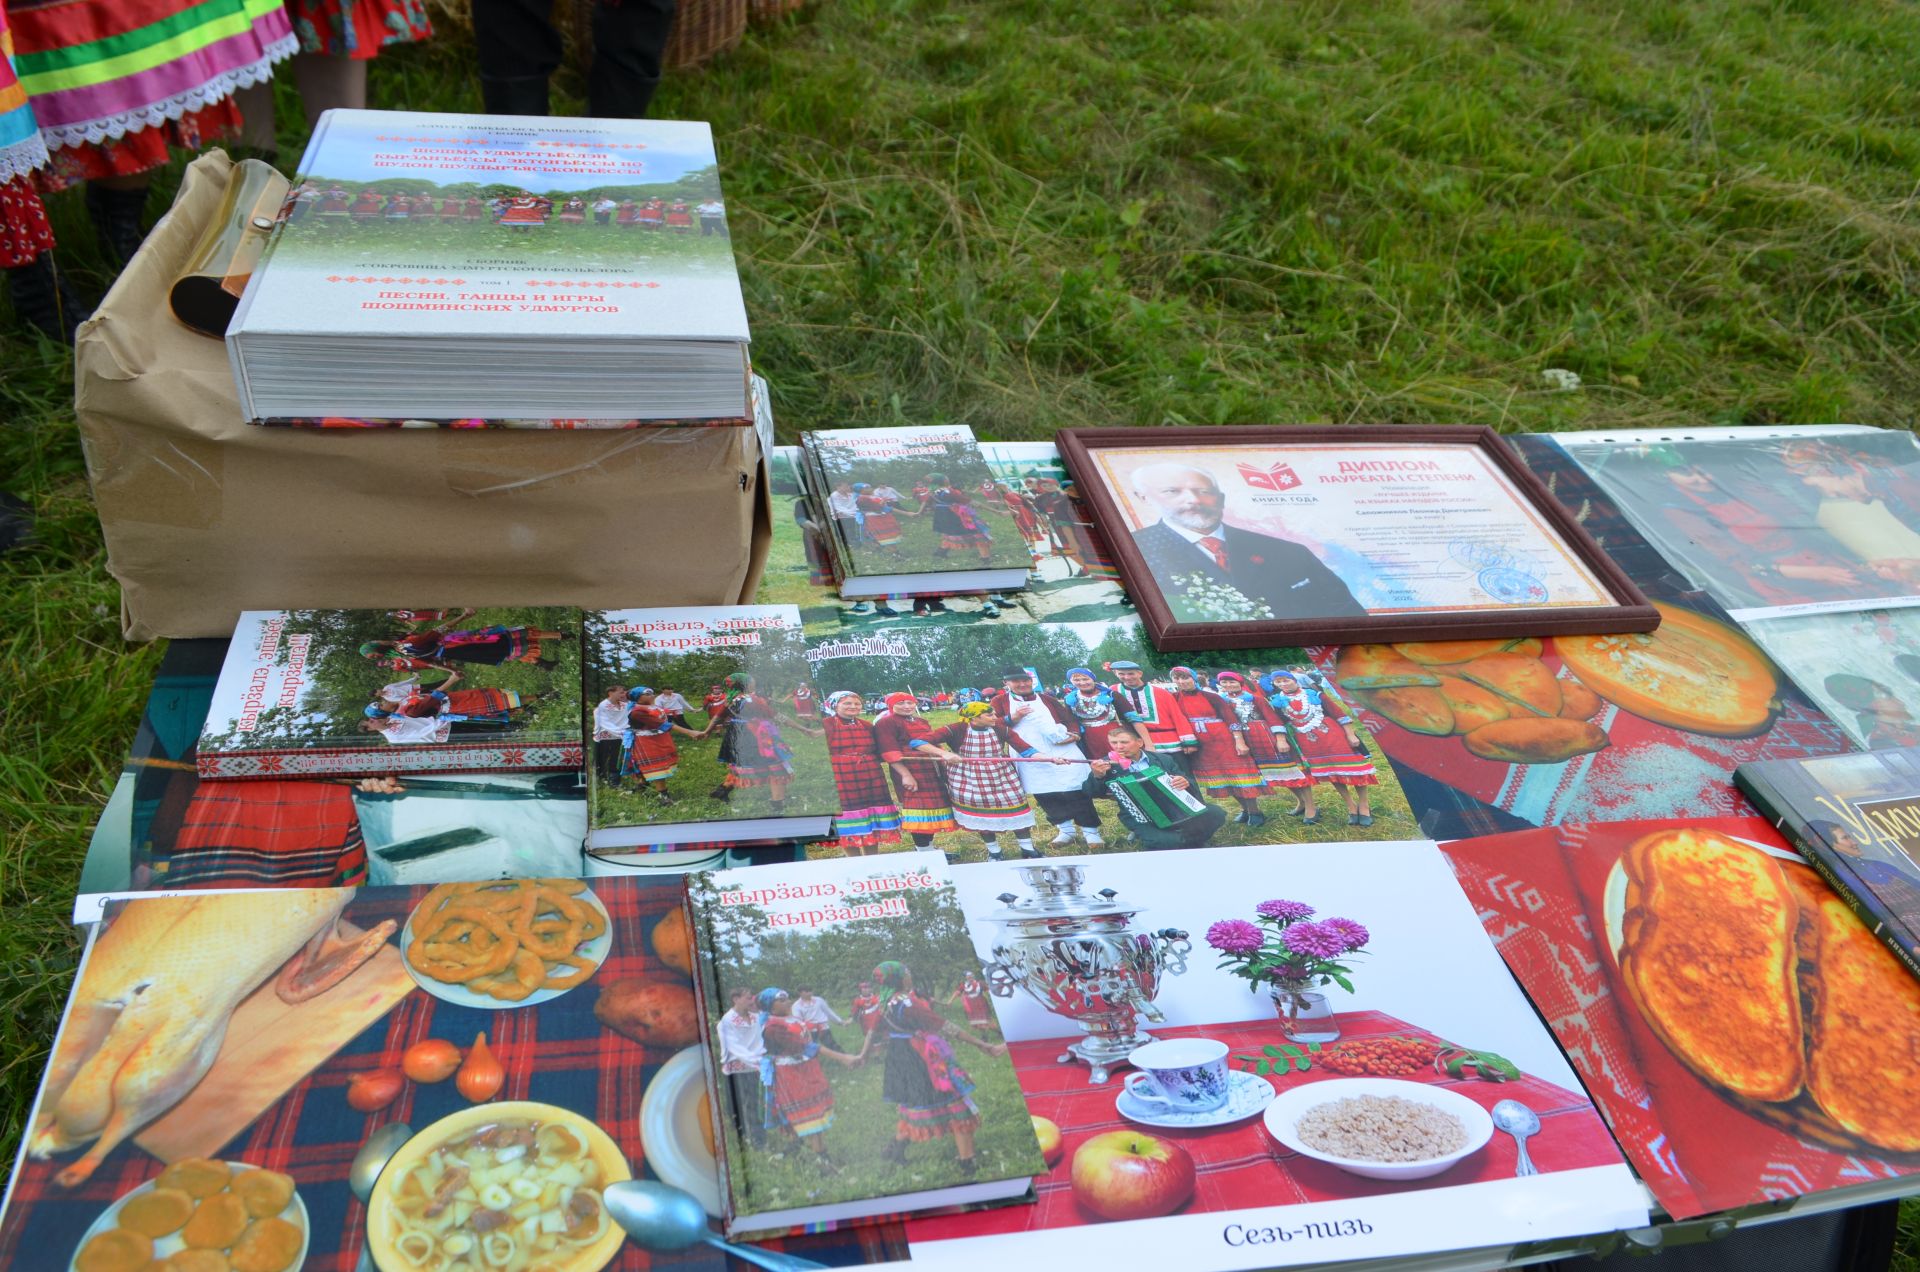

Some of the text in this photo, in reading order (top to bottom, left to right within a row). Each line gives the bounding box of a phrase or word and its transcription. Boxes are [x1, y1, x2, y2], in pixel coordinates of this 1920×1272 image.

[412, 147, 479, 155] ШОШМА
[378, 291, 450, 300] ПЕСНИ,
[458, 293, 527, 301] ТАНЦЫ
[552, 294, 606, 302] ИГРЫ
[361, 302, 620, 312] ШОШМИНСКИХ УДМУРТОВ
[1337, 460, 1442, 474] ДИПЛОМ
[1319, 474, 1397, 484] ЛАУРЕАТА
[1407, 473, 1476, 482] СТЕПЕНИ
[1223, 1218, 1373, 1247] Сезь-пизь
